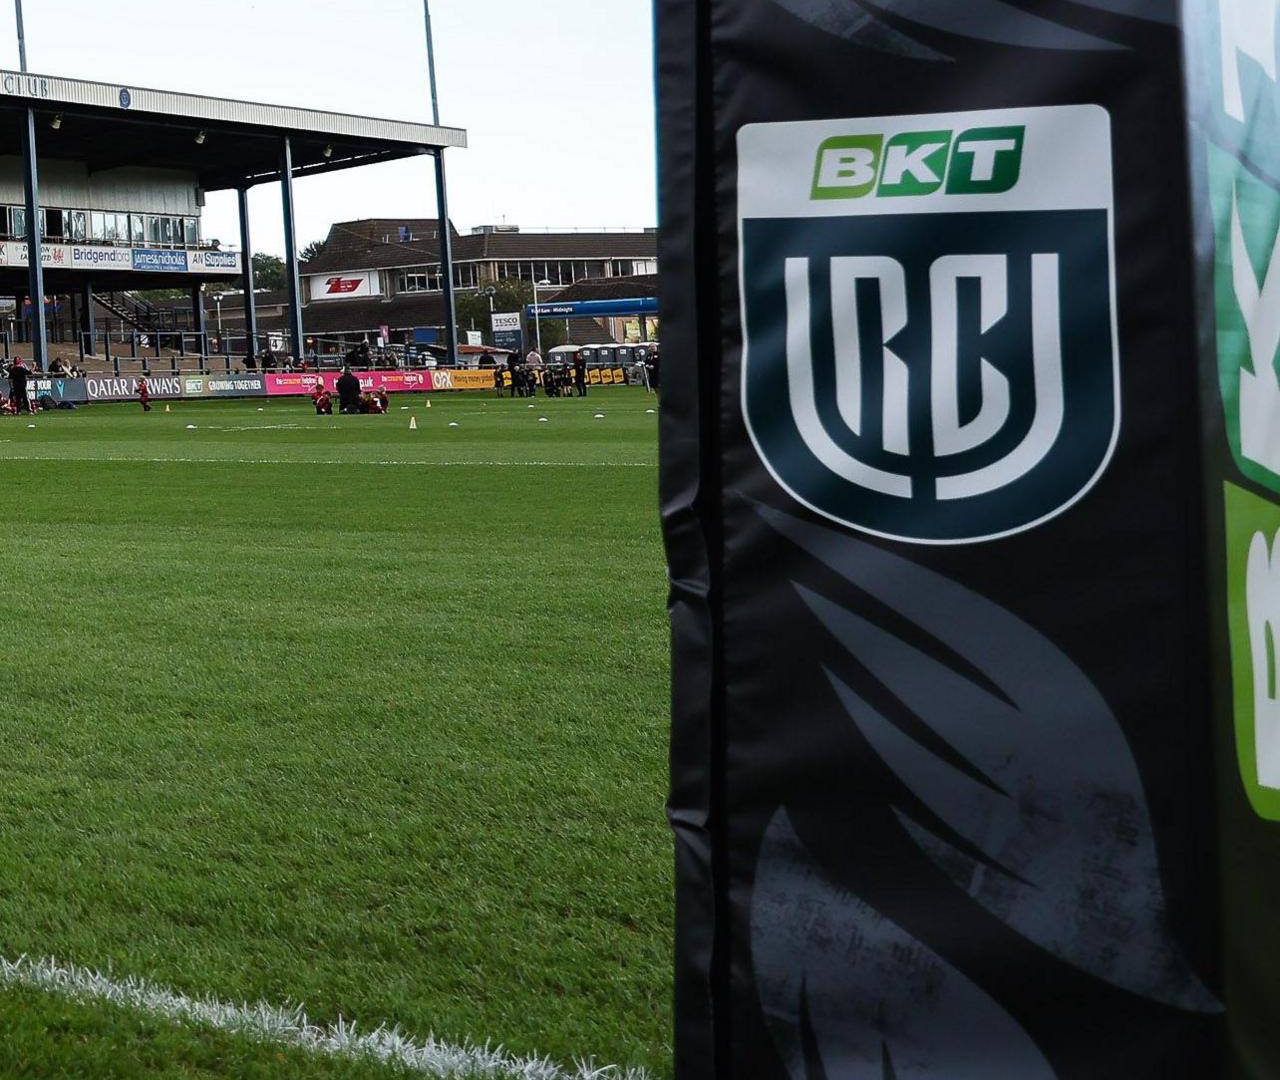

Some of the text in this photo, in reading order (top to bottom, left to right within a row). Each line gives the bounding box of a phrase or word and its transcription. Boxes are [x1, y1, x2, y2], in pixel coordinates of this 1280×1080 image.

[4, 75, 49, 98] CLUB
[816, 138, 1016, 189] BKT
[73, 248, 130, 263] Bridgendford
[192, 254, 236, 267] AN Supplies
[36, 380, 52, 391] YOUR
[208, 381, 234, 391] GROWING
[234, 379, 262, 391] TOGETHER
[434, 370, 453, 387] OFX
[87, 377, 181, 397] QATAR ARWAYS
